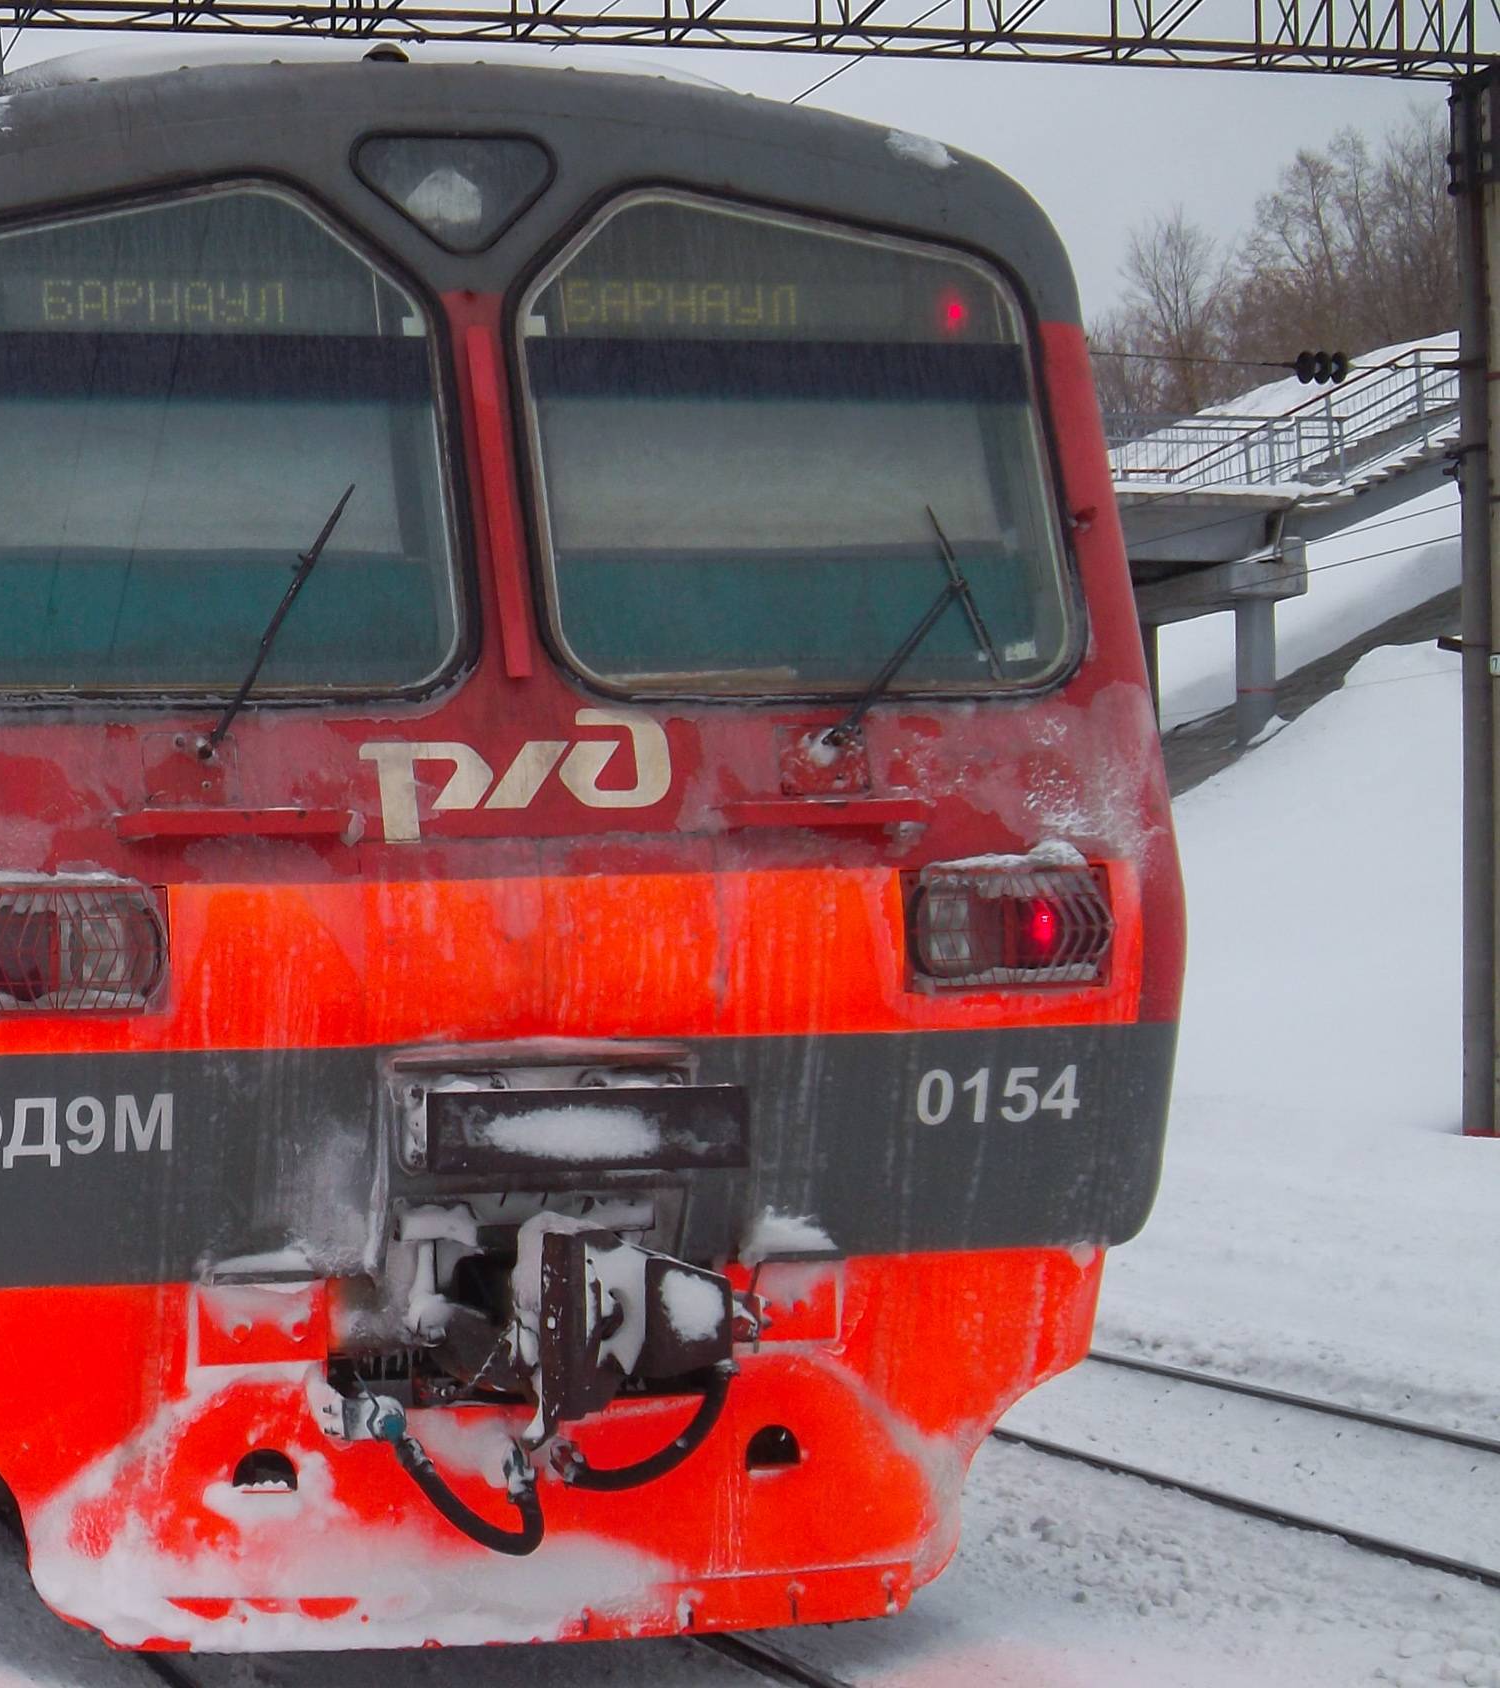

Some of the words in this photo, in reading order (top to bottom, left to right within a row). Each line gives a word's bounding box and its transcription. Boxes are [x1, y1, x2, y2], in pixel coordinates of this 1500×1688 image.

[42, 280, 286, 323] БАРНАУЛ
[566, 281, 798, 325] БАРНАУЛ
[917, 1065, 1080, 1124] 0154
